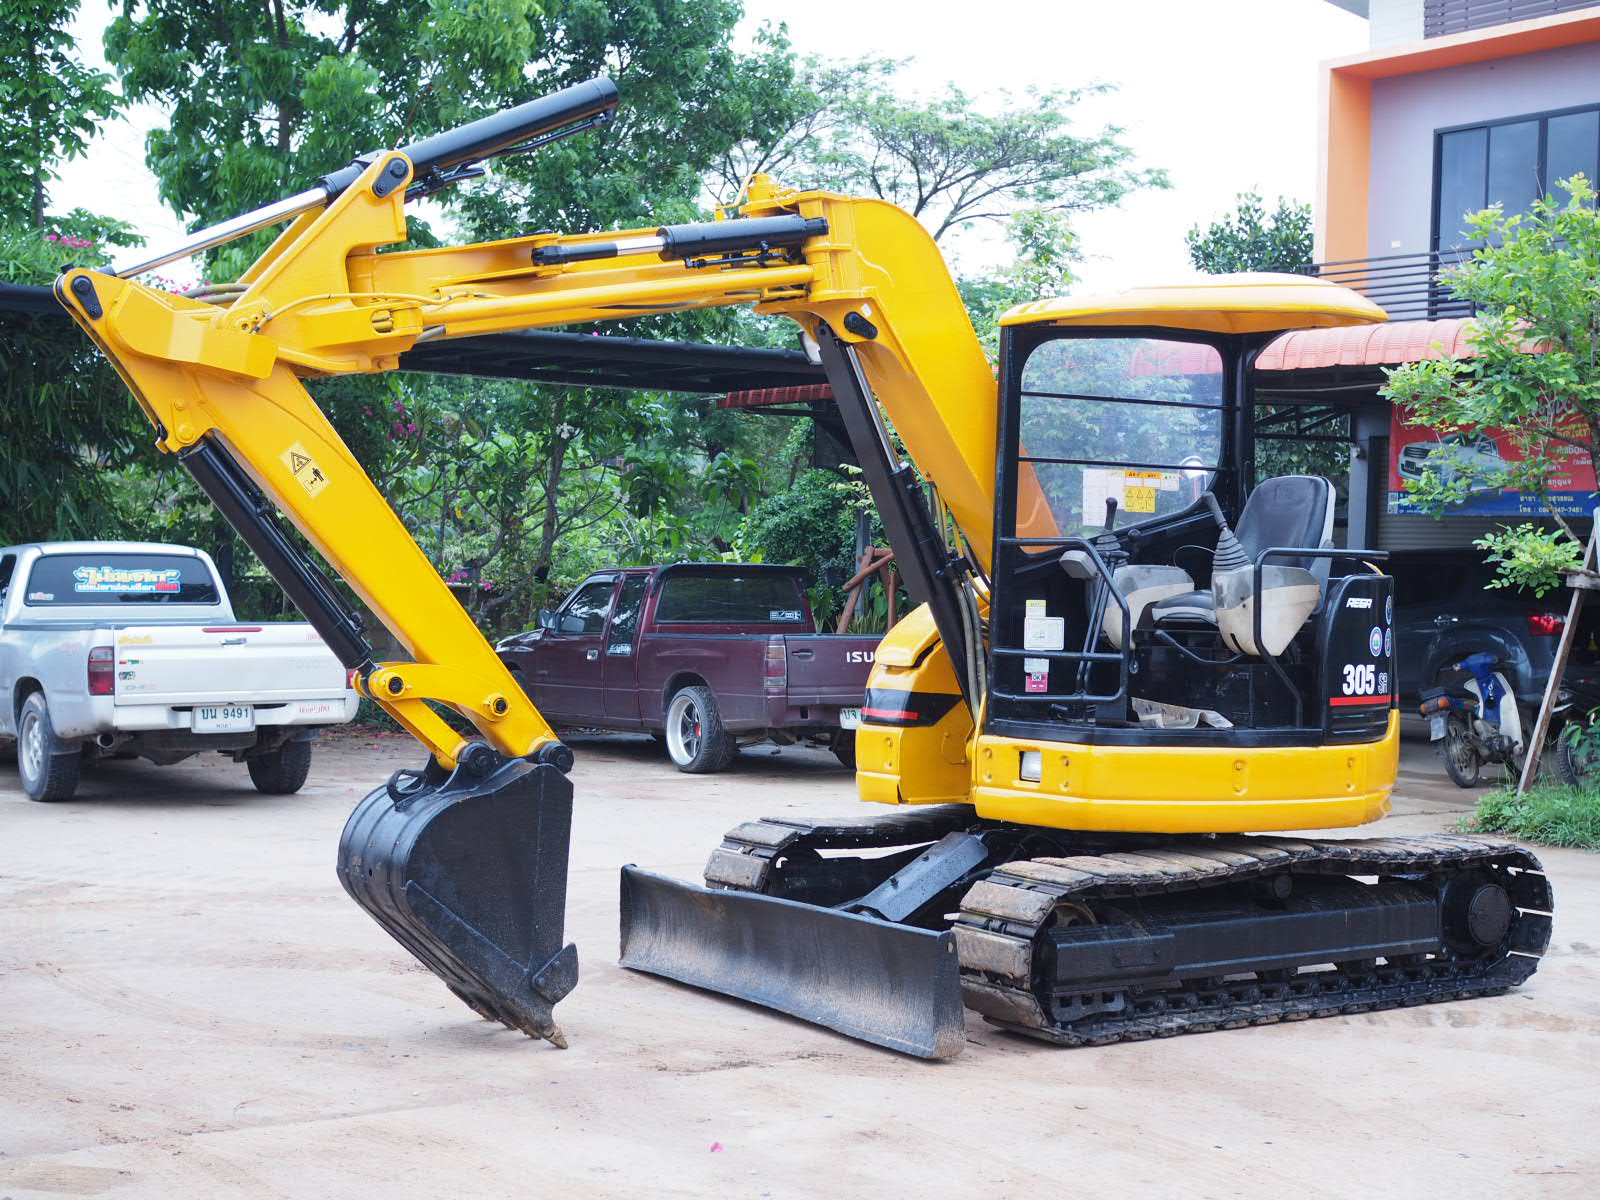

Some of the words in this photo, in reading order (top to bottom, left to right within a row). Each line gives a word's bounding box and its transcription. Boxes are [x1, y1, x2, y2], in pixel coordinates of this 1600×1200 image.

[846, 651, 875, 663] ISU
[1342, 664, 1376, 695] 305
[223, 707, 248, 719] 9491
